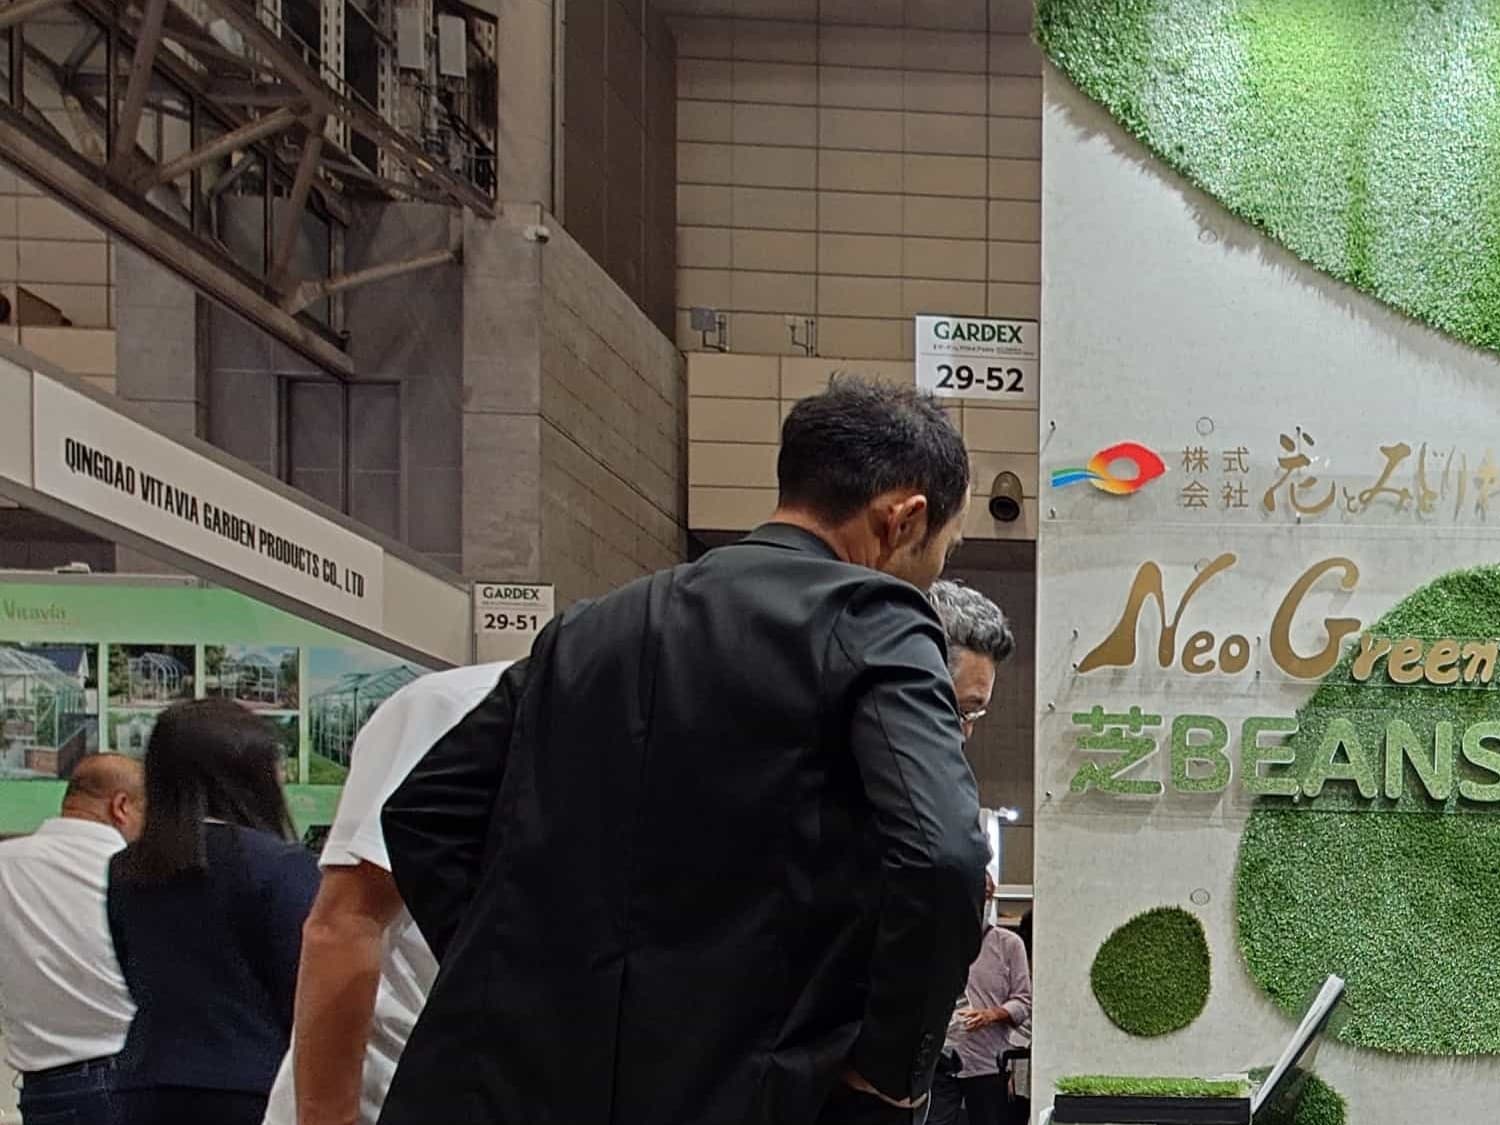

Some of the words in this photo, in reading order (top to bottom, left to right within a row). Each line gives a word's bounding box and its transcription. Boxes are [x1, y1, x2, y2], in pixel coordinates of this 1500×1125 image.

[933, 321, 1024, 343] GARDEX
[936, 364, 1024, 392] 29-52
[64, 437, 136, 495] QINGDAO
[140, 472, 199, 525] VITAVIA
[203, 502, 256, 550] GARDEN
[258, 529, 320, 578] PRODUCTS
[346, 570, 365, 598] LTD
[483, 586, 540, 600] GARDEX
[484, 613, 537, 630] 29-51
[1077, 553, 1250, 673] Neo
[1269, 557, 1500, 684] Green
